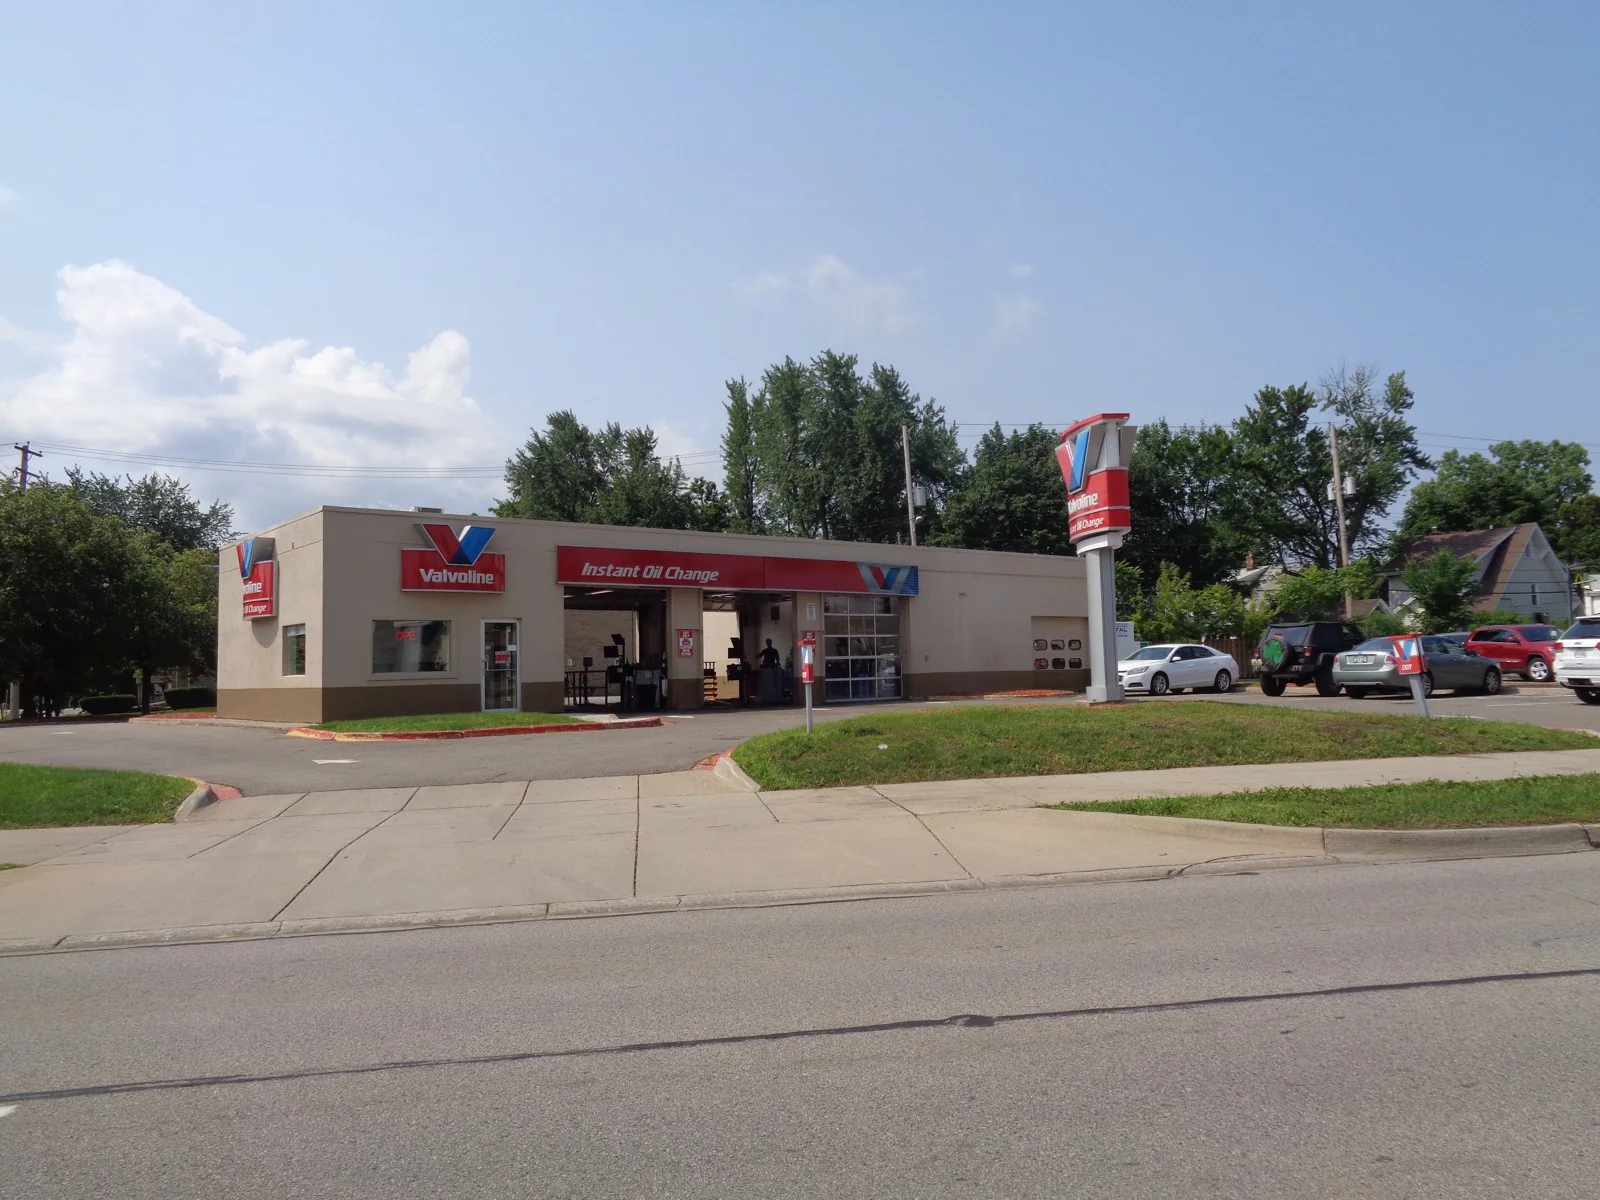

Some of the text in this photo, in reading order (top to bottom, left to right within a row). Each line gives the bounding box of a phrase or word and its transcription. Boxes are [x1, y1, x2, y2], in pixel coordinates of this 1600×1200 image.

[1082, 517, 1104, 529] Change
[419, 568, 495, 584] Valvoline
[581, 562, 720, 583] Instant Oil Change
